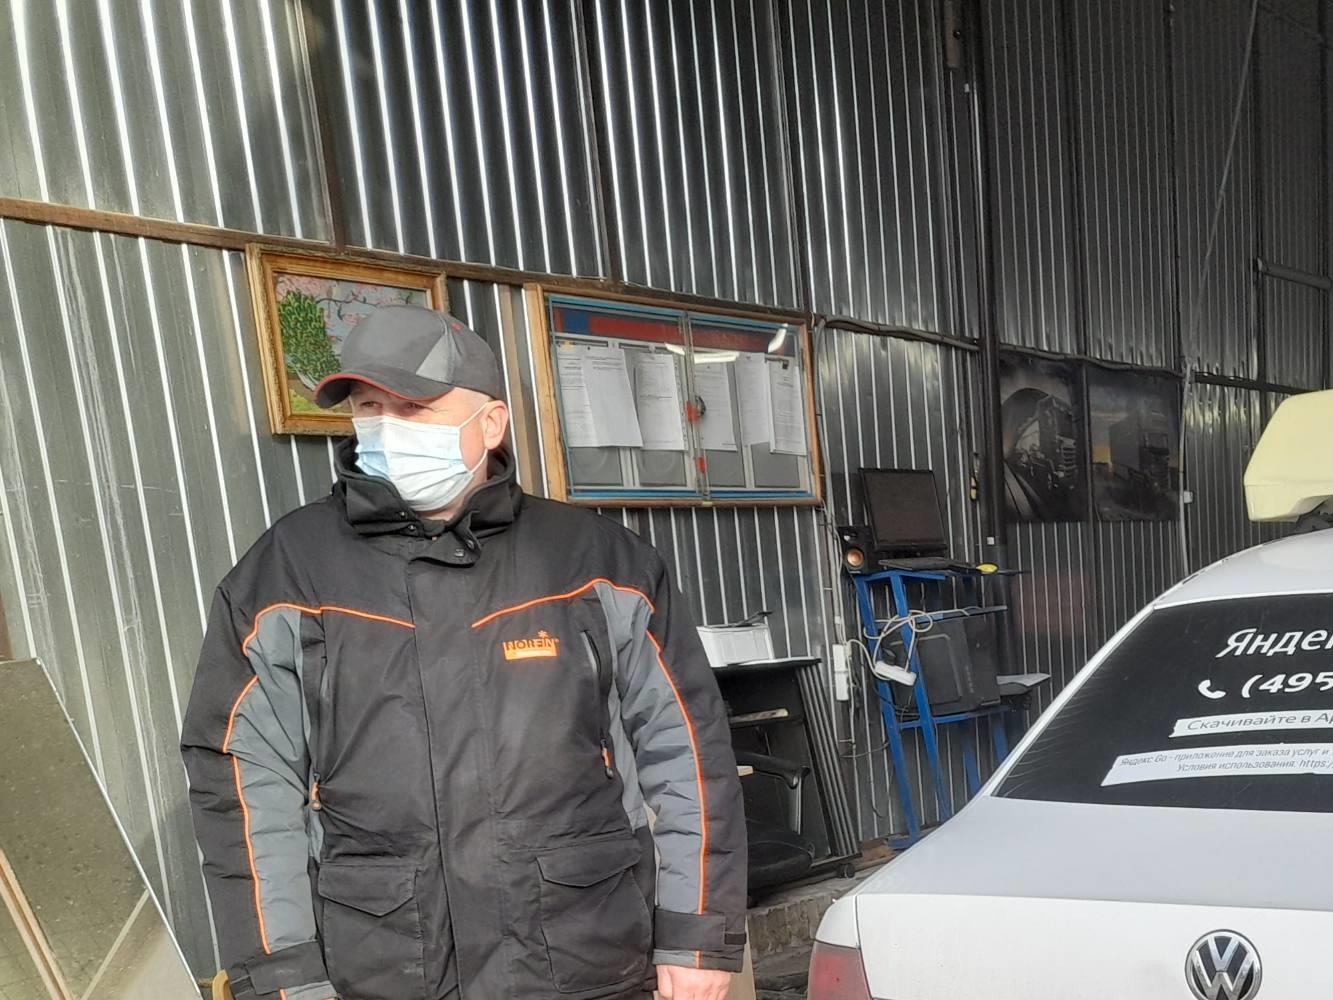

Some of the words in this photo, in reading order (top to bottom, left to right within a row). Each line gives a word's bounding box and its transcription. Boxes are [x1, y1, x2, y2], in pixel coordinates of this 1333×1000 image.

[1187, 714, 1296, 730] Скачивайте
[1174, 750, 1234, 761] приложение
[1235, 750, 1254, 759] для
[1255, 749, 1290, 757] заказа
[1292, 749, 1320, 758] услуг
[1176, 761, 1217, 772] Условия
